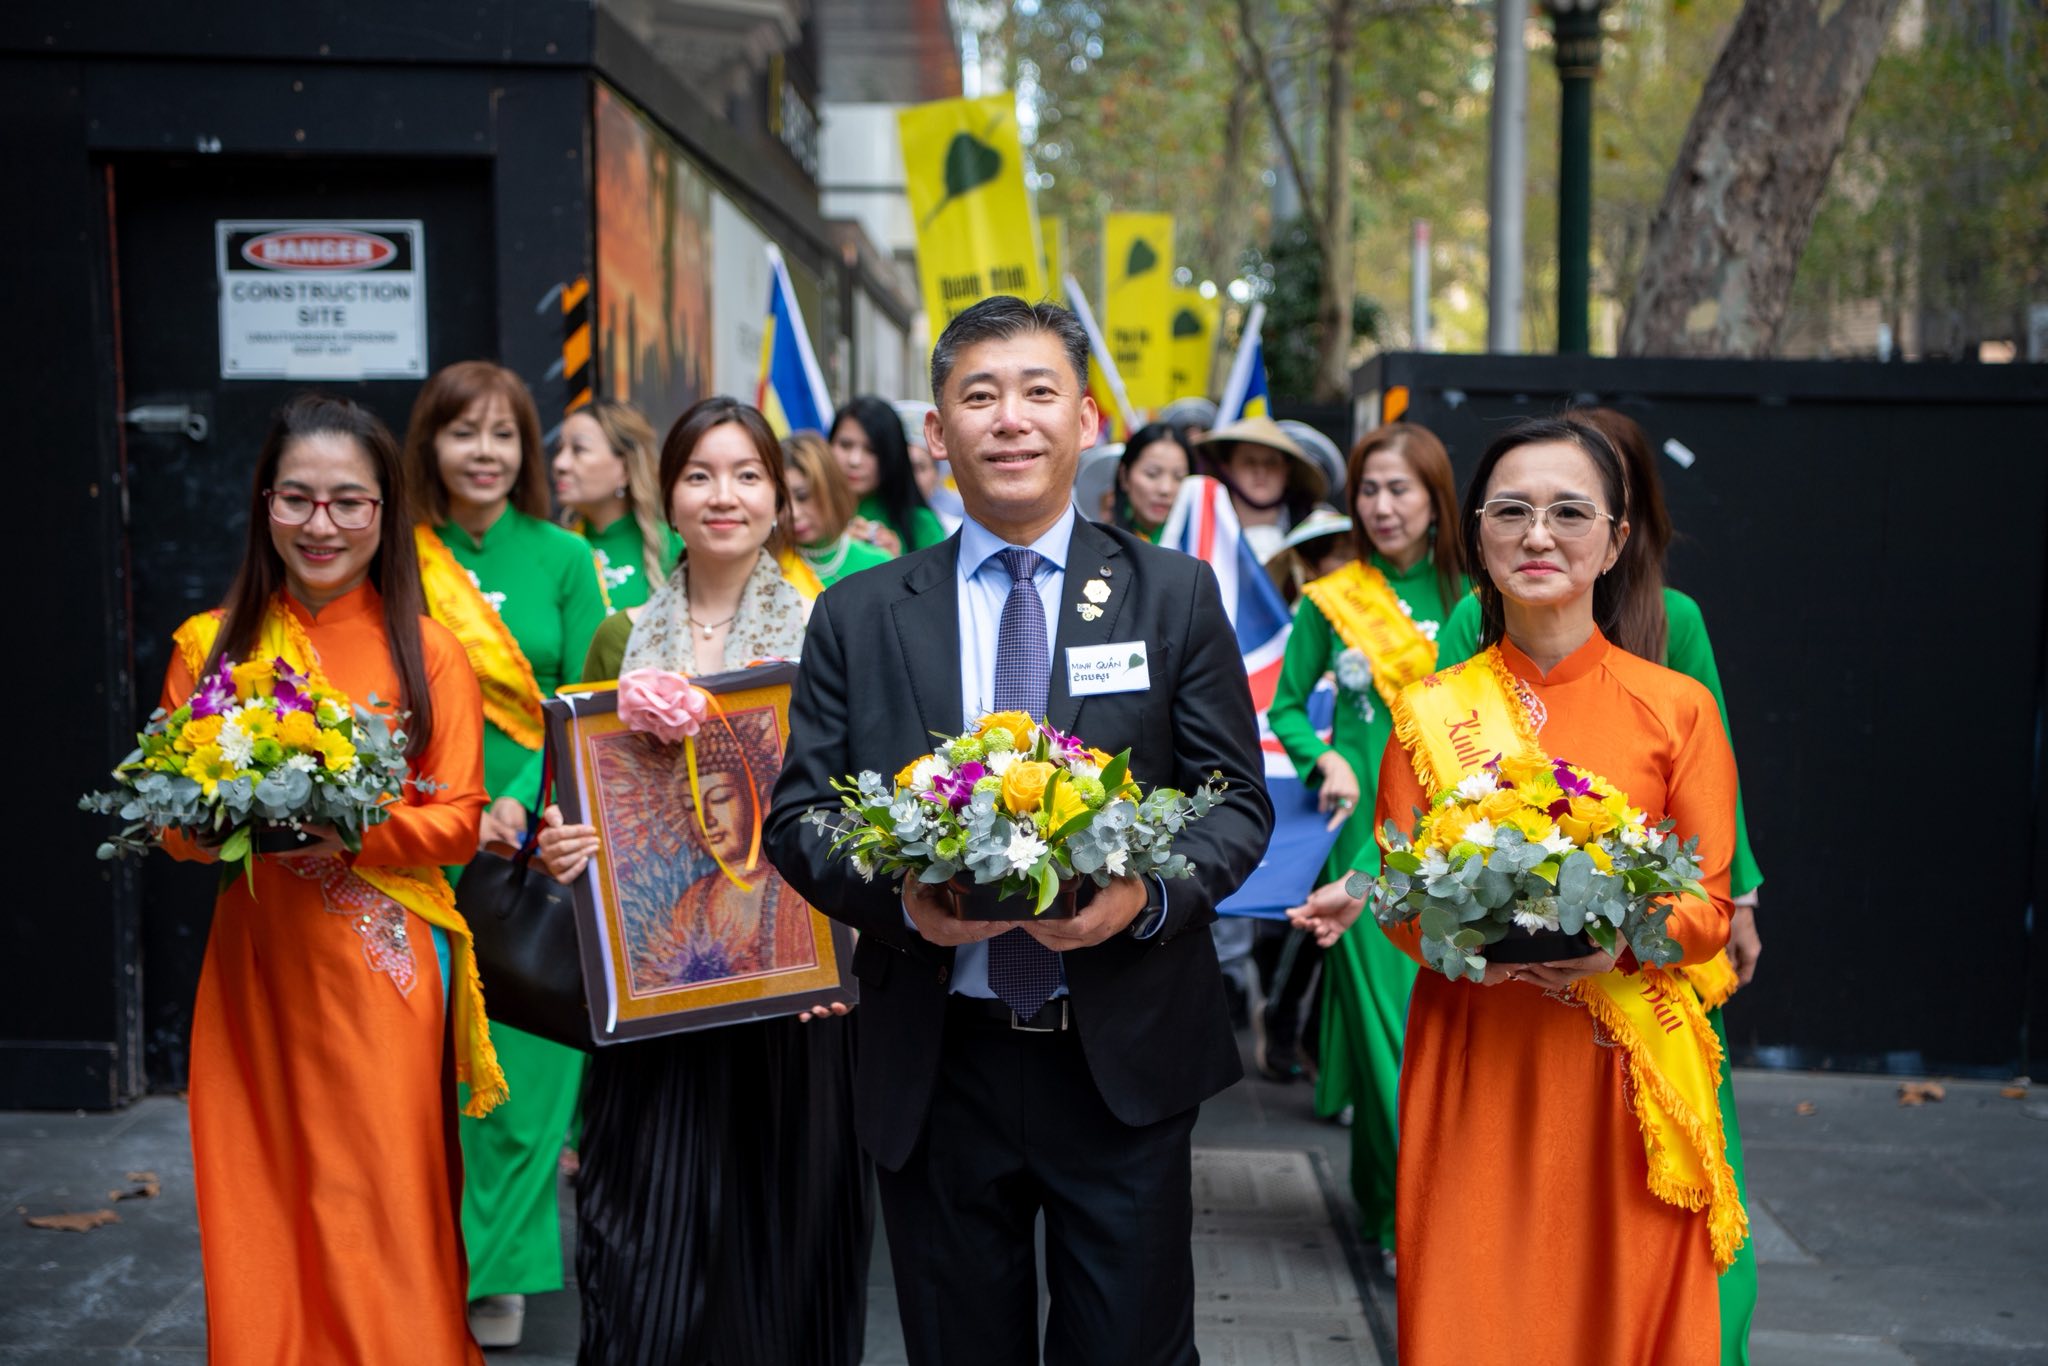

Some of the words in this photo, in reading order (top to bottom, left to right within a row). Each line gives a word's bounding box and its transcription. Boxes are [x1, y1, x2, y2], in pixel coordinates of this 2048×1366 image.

[263, 239, 372, 261] DANGER
[232, 281, 411, 301] CONSTRUCTION
[298, 307, 346, 326] SITE
[1071, 662, 1092, 670] MINH
